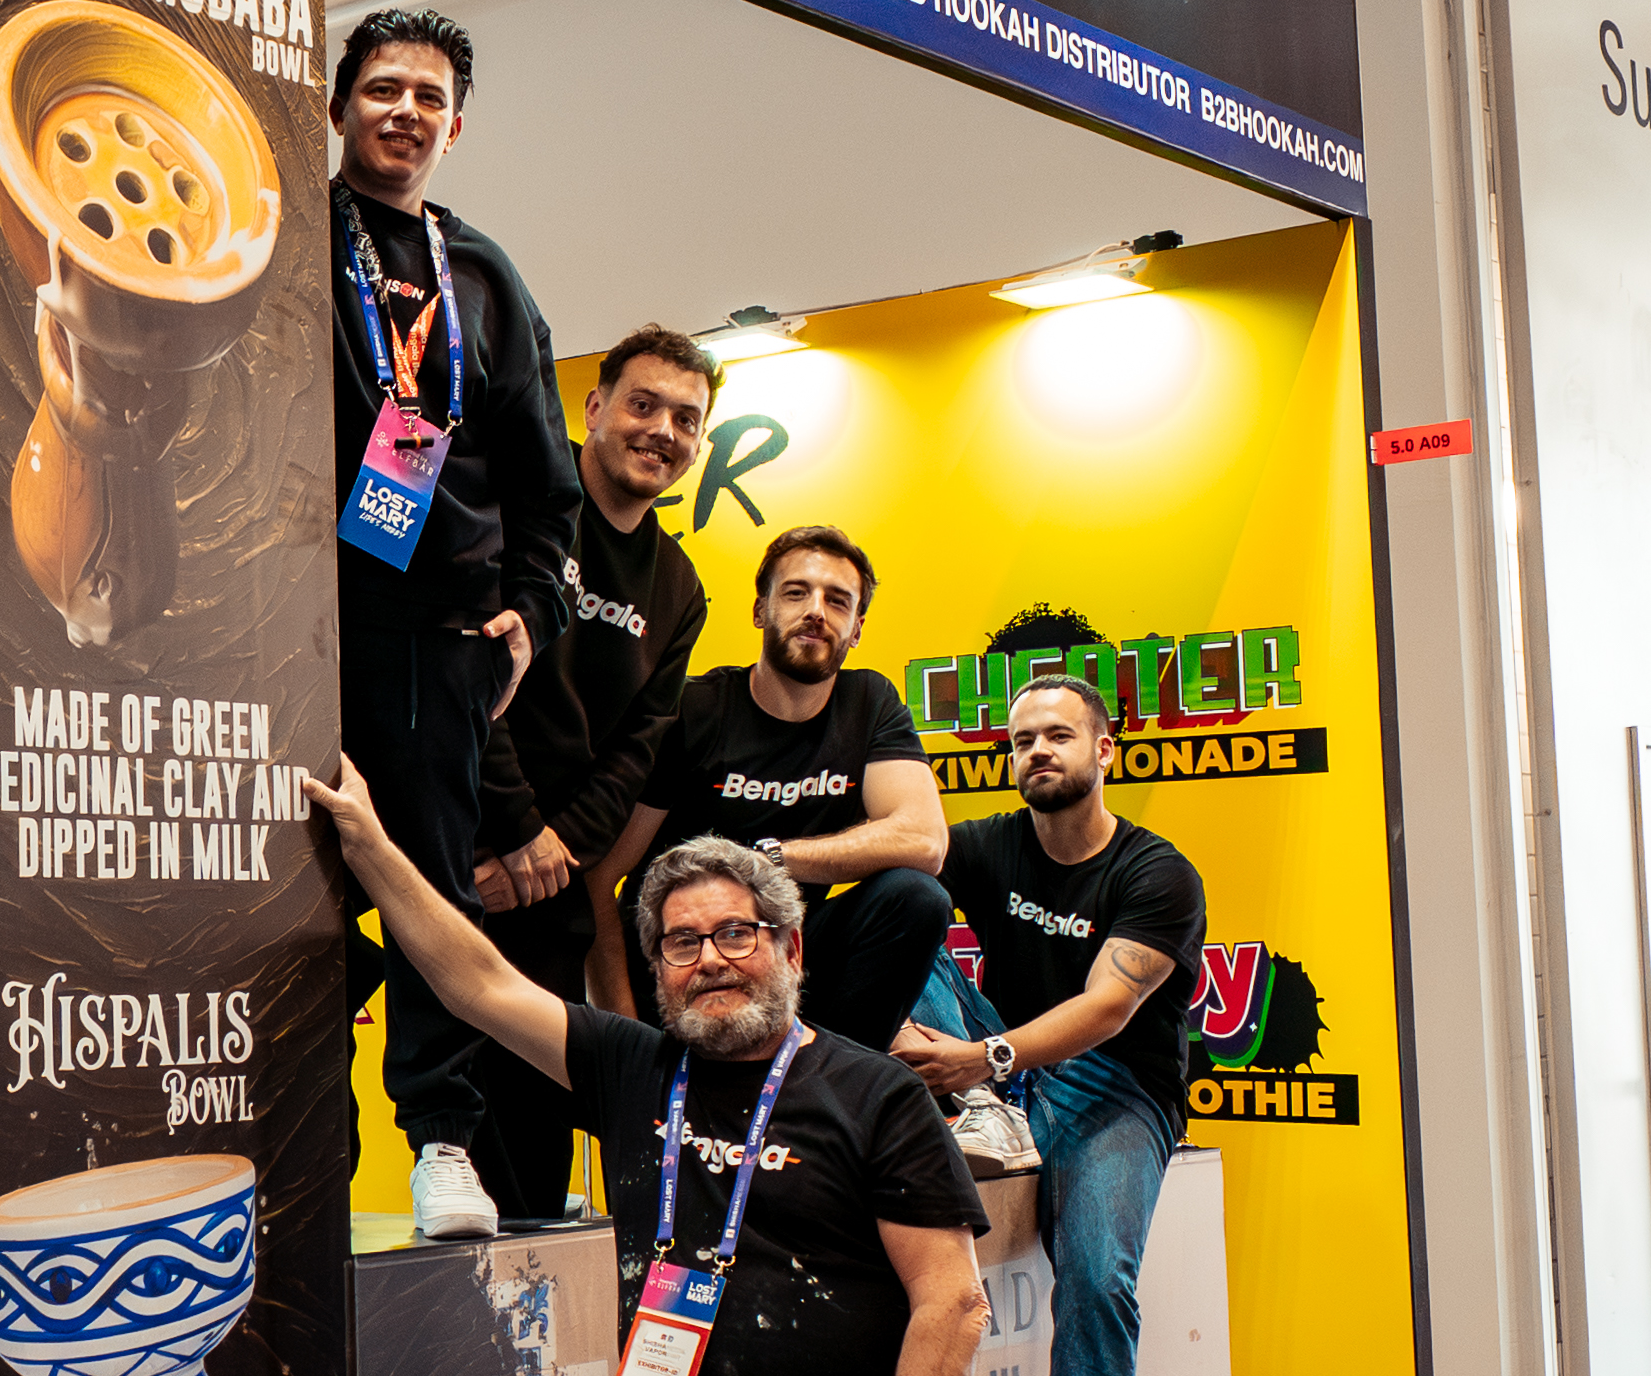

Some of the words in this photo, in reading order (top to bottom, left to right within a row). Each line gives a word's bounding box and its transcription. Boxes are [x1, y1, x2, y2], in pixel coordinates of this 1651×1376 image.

[252, 34, 315, 87] BOWL
[1046, 23, 1191, 115] DISTRIBUTOR
[1199, 87, 1364, 184] B2BHOOKAH.COM
[1389, 435, 1415, 456] 5.0
[1419, 432, 1451, 453] A09
[358, 493, 416, 532] MARY
[364, 478, 418, 517] LOST
[14, 685, 110, 751] MADE
[121, 694, 162, 754] OF
[172, 698, 269, 760] GREEN
[163, 758, 242, 819] CLAY
[252, 765, 310, 821] AND
[722, 769, 848, 807] Bengala
[18, 817, 137, 879] DIPPED
[150, 821, 179, 880] IN
[192, 825, 270, 881] MILK
[686, 1291, 717, 1306] MARY
[689, 1281, 718, 1297] LOST
